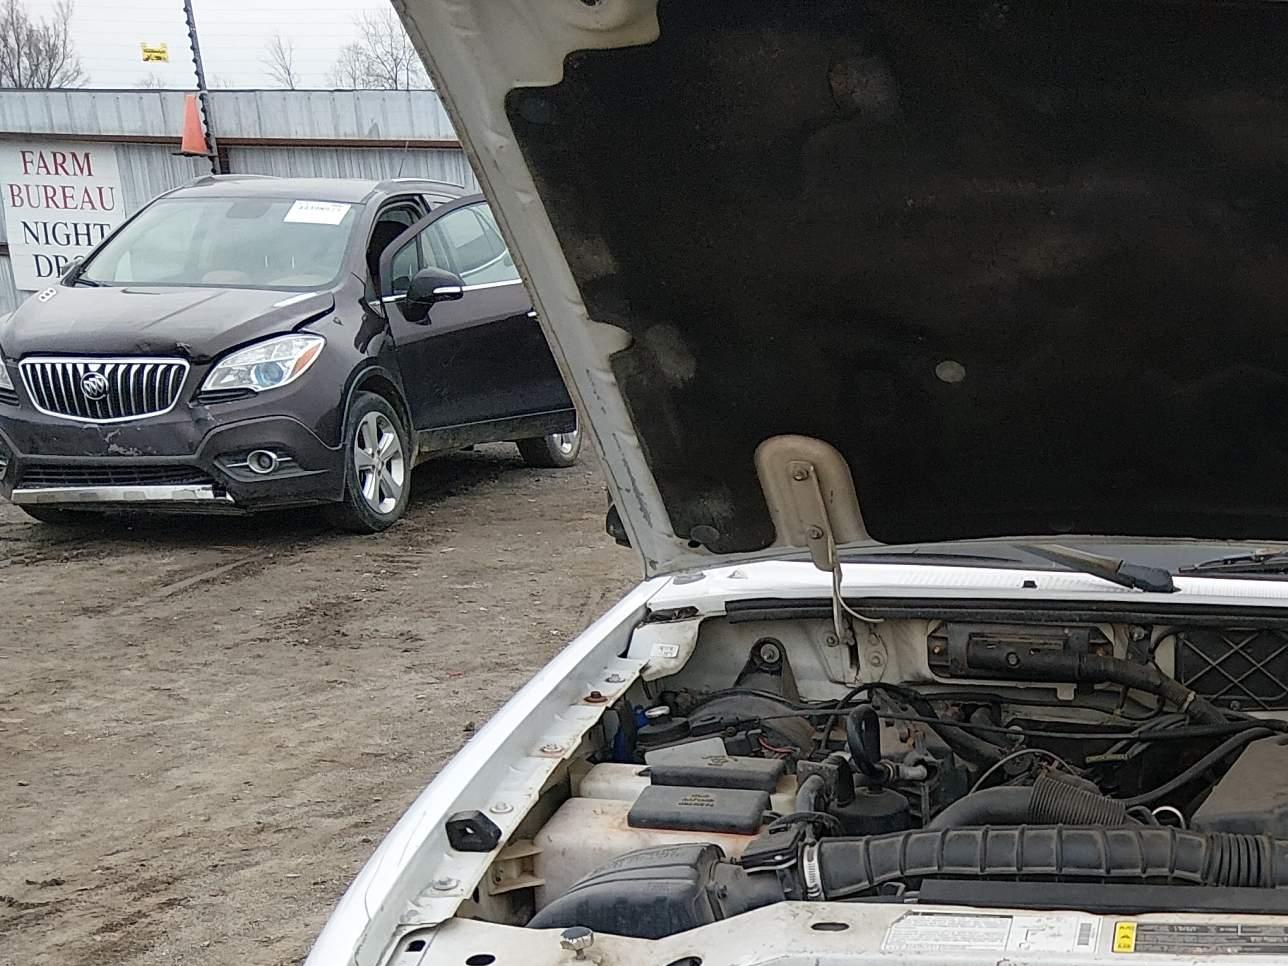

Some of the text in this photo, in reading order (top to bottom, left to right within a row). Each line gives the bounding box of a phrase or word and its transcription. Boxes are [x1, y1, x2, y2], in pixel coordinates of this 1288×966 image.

[20, 150, 94, 176] FARM
[8, 183, 115, 211] BUREAU
[20, 220, 111, 246] NIGHT
[33, 253, 86, 278] DR
